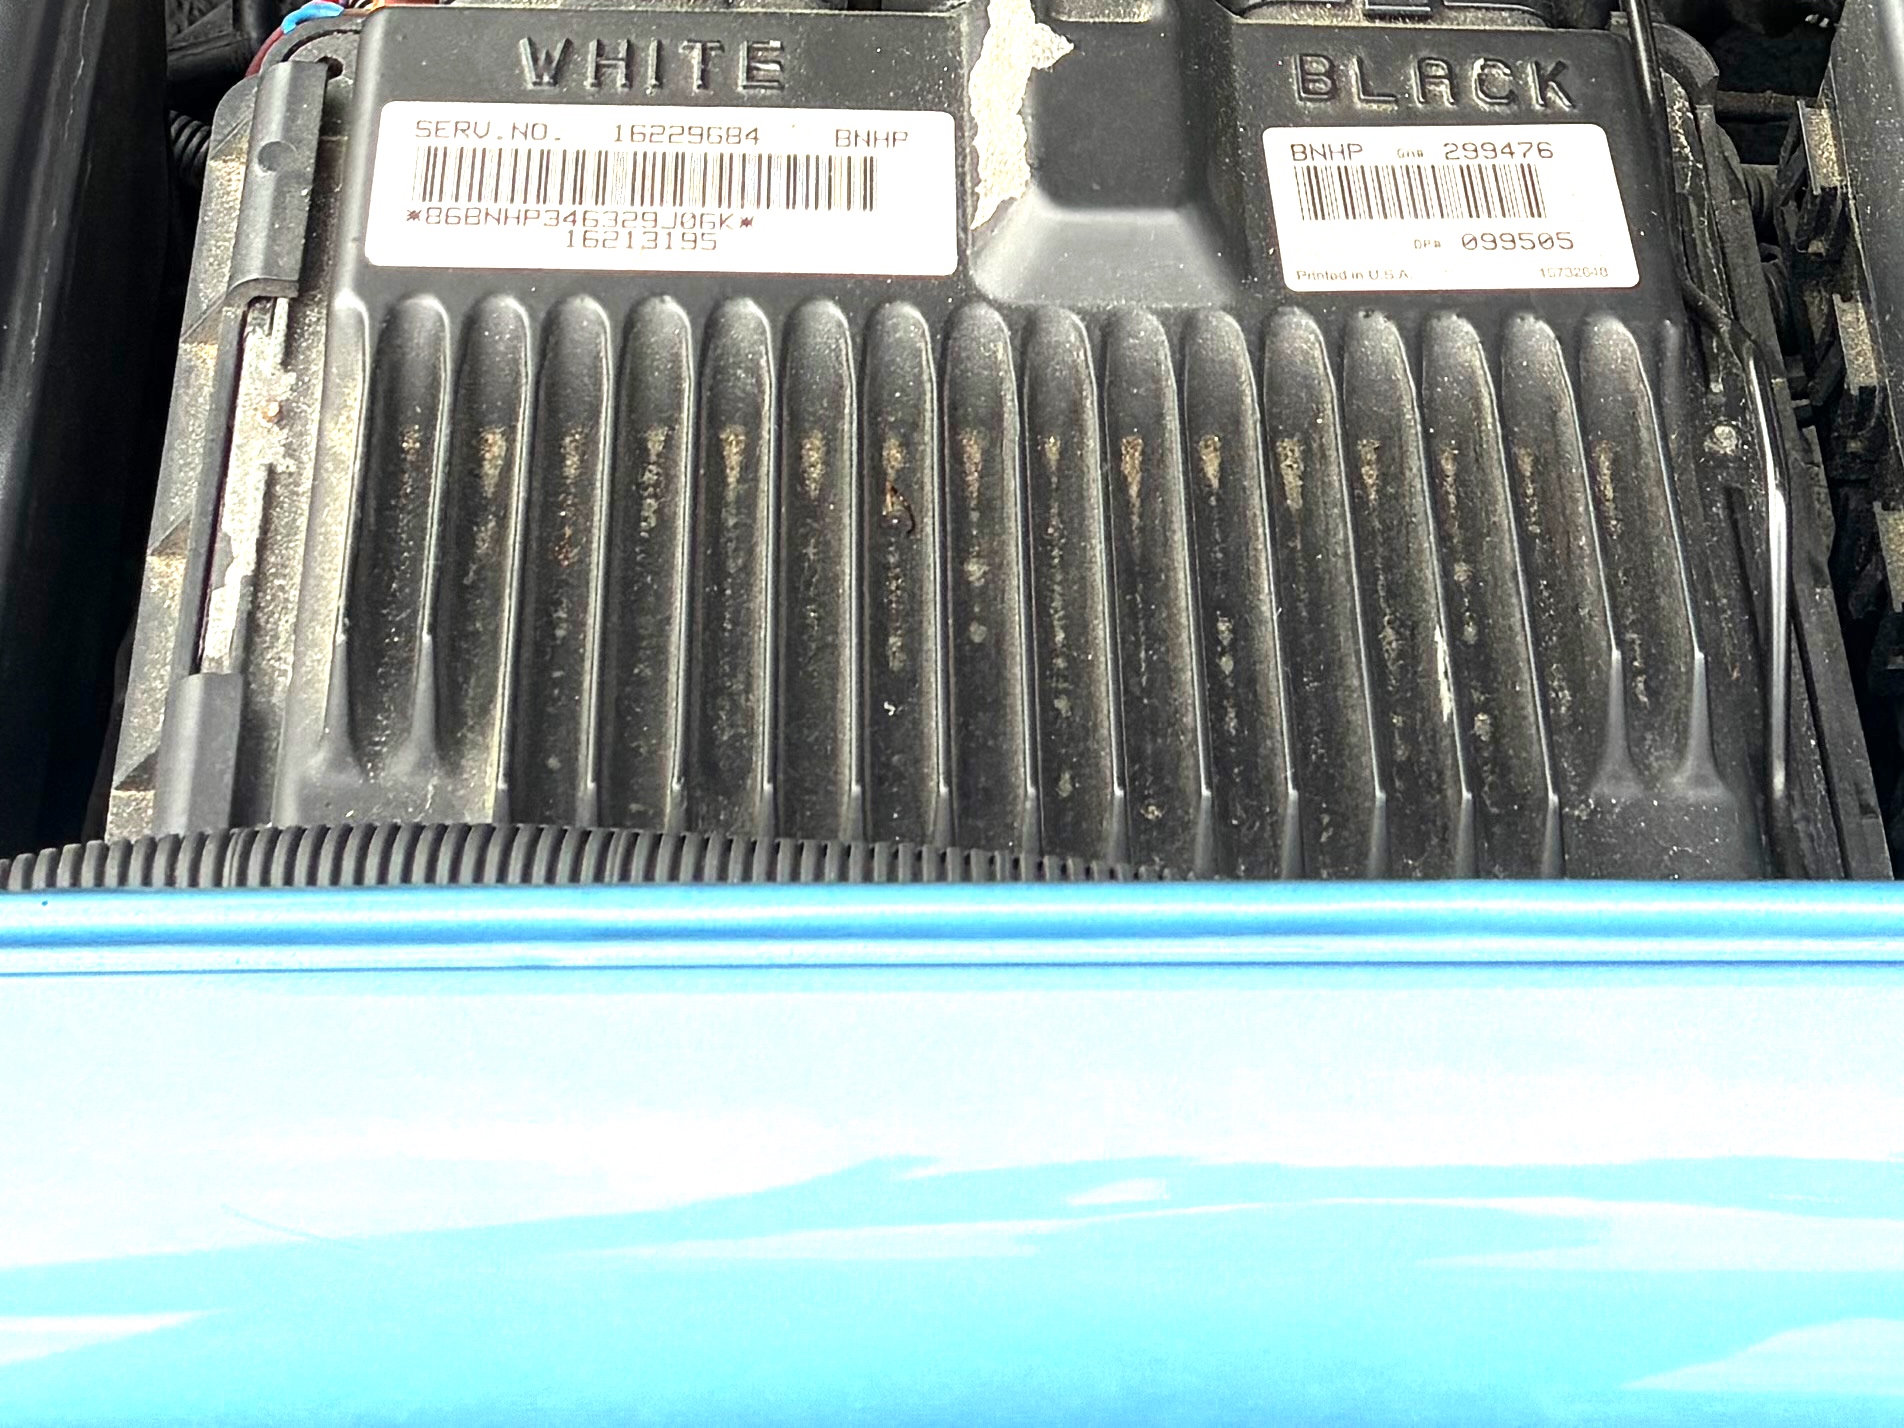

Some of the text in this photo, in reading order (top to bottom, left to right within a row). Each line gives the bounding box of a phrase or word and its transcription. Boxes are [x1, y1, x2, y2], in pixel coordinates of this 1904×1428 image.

[518, 36, 786, 93] WHITE
[1292, 53, 1576, 110] BLACK
[834, 127, 909, 149] BNHP
[1290, 143, 1364, 162] BNHP
[1443, 141, 1555, 161] 299476
[566, 230, 718, 252] 16213195
[1461, 231, 1575, 251] 099505
[1296, 269, 1348, 282] Printed
